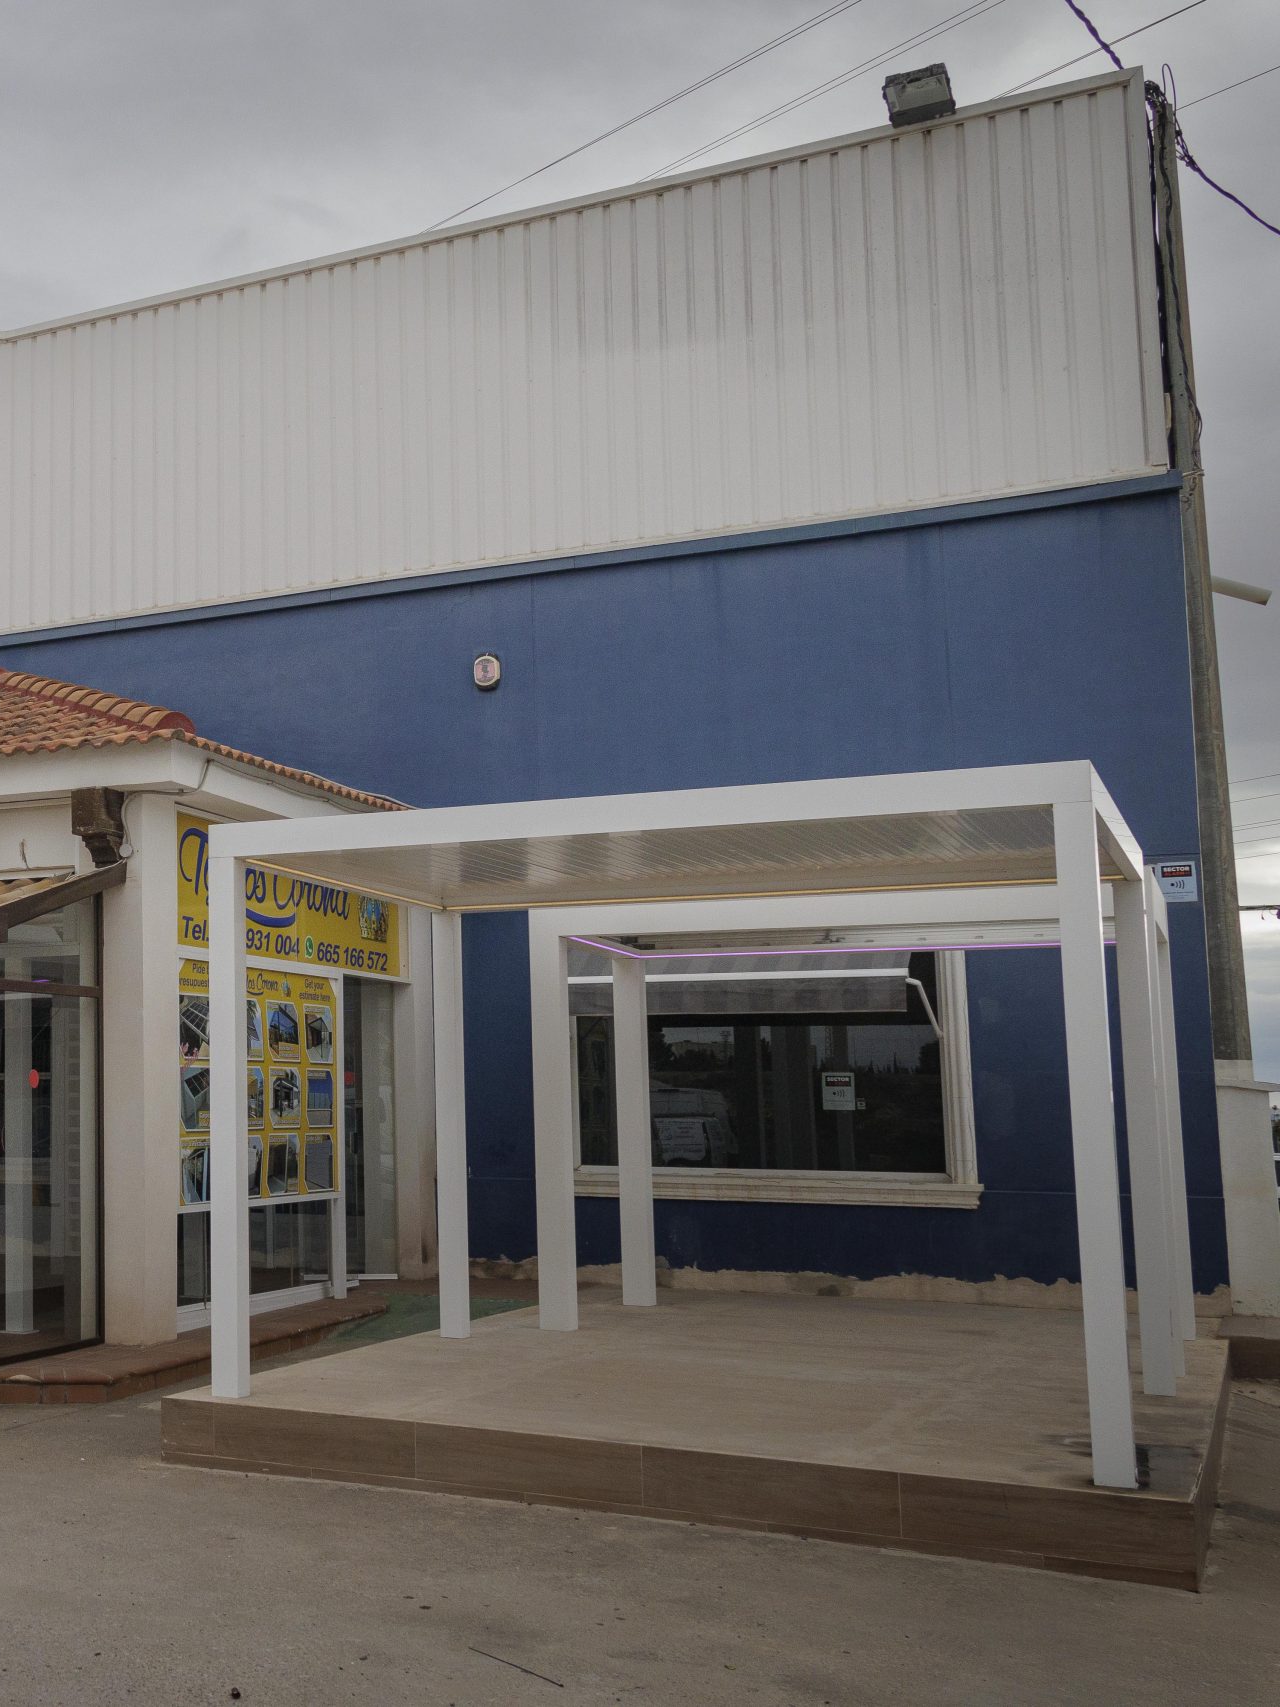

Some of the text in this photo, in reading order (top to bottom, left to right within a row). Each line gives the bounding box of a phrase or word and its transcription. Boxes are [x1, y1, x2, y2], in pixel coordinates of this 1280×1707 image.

[246, 928, 270, 952] 931
[275, 934, 300, 956] 004
[317, 942, 340, 964] 665
[343, 948, 365, 969] 166
[367, 951, 388, 972] 572
